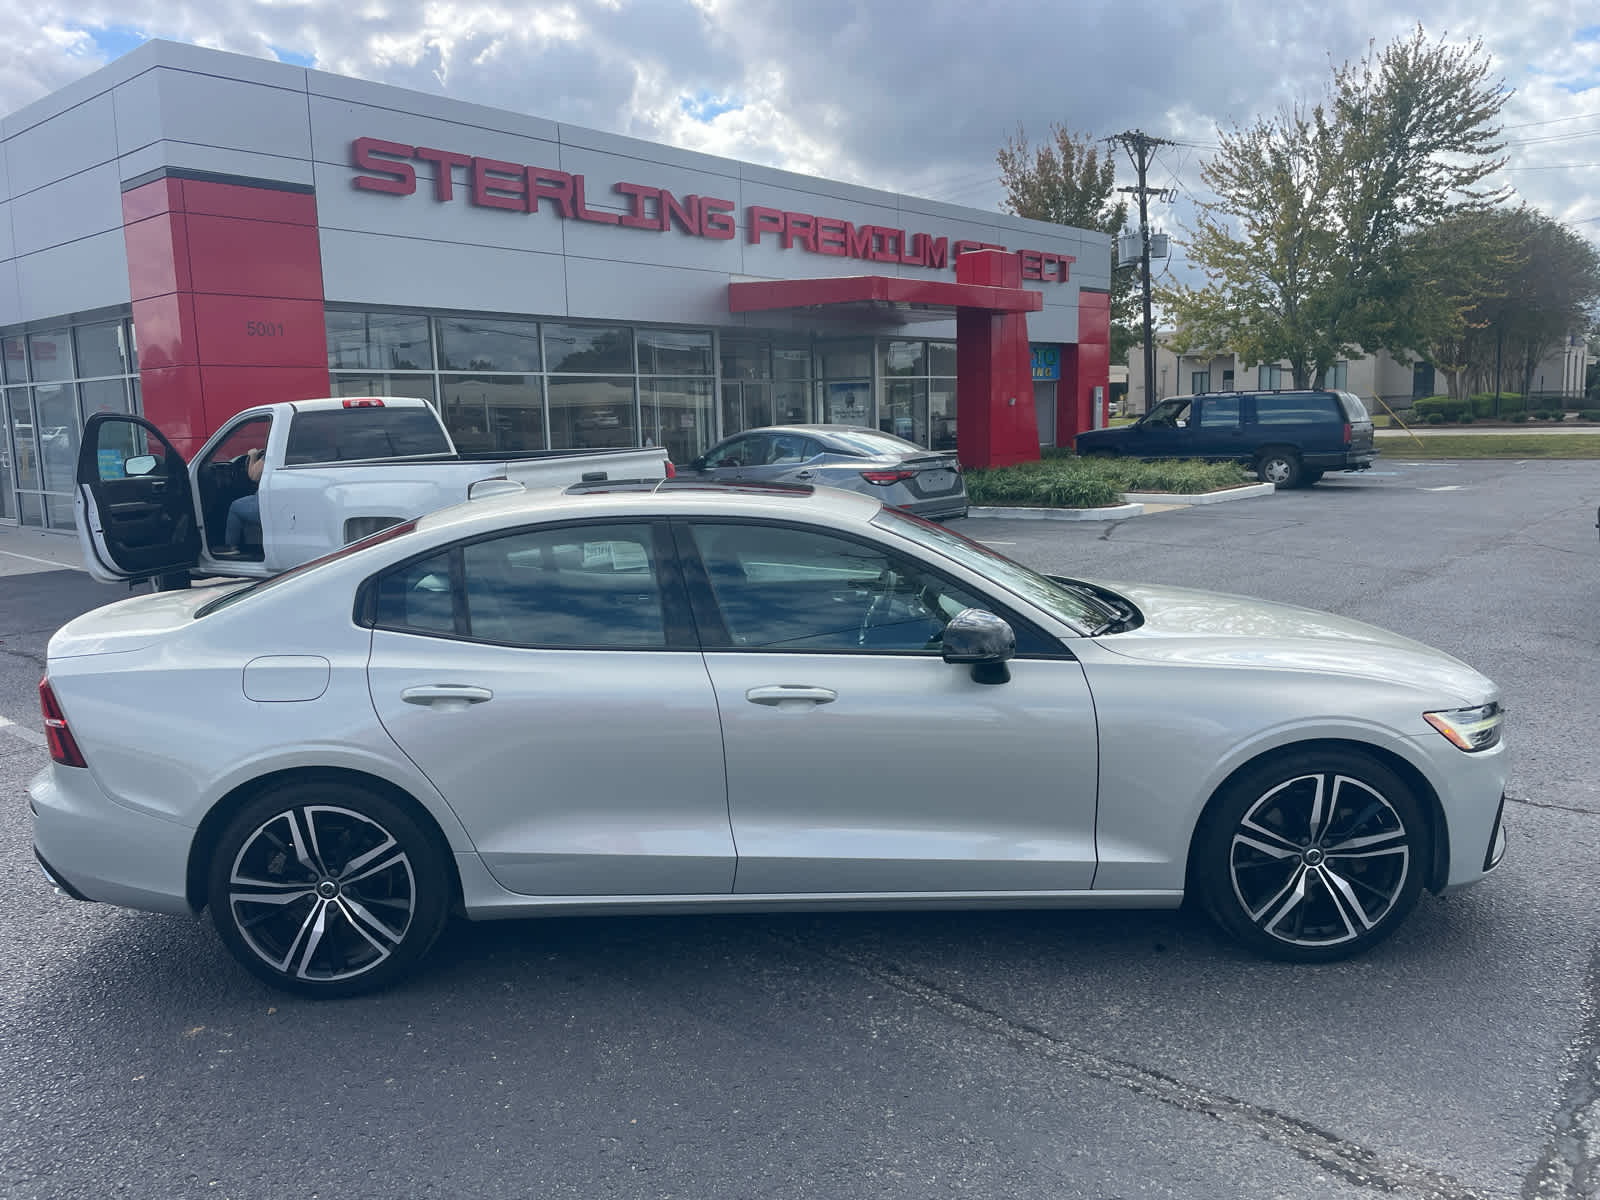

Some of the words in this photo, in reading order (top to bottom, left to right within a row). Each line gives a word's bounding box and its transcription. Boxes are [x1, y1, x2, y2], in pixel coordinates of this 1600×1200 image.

[352, 137, 736, 240] STERLING
[749, 206, 948, 268] PREMIUM
[954, 240, 1077, 283] ECT
[247, 320, 284, 337] 5001
[1031, 349, 1058, 366] TO
